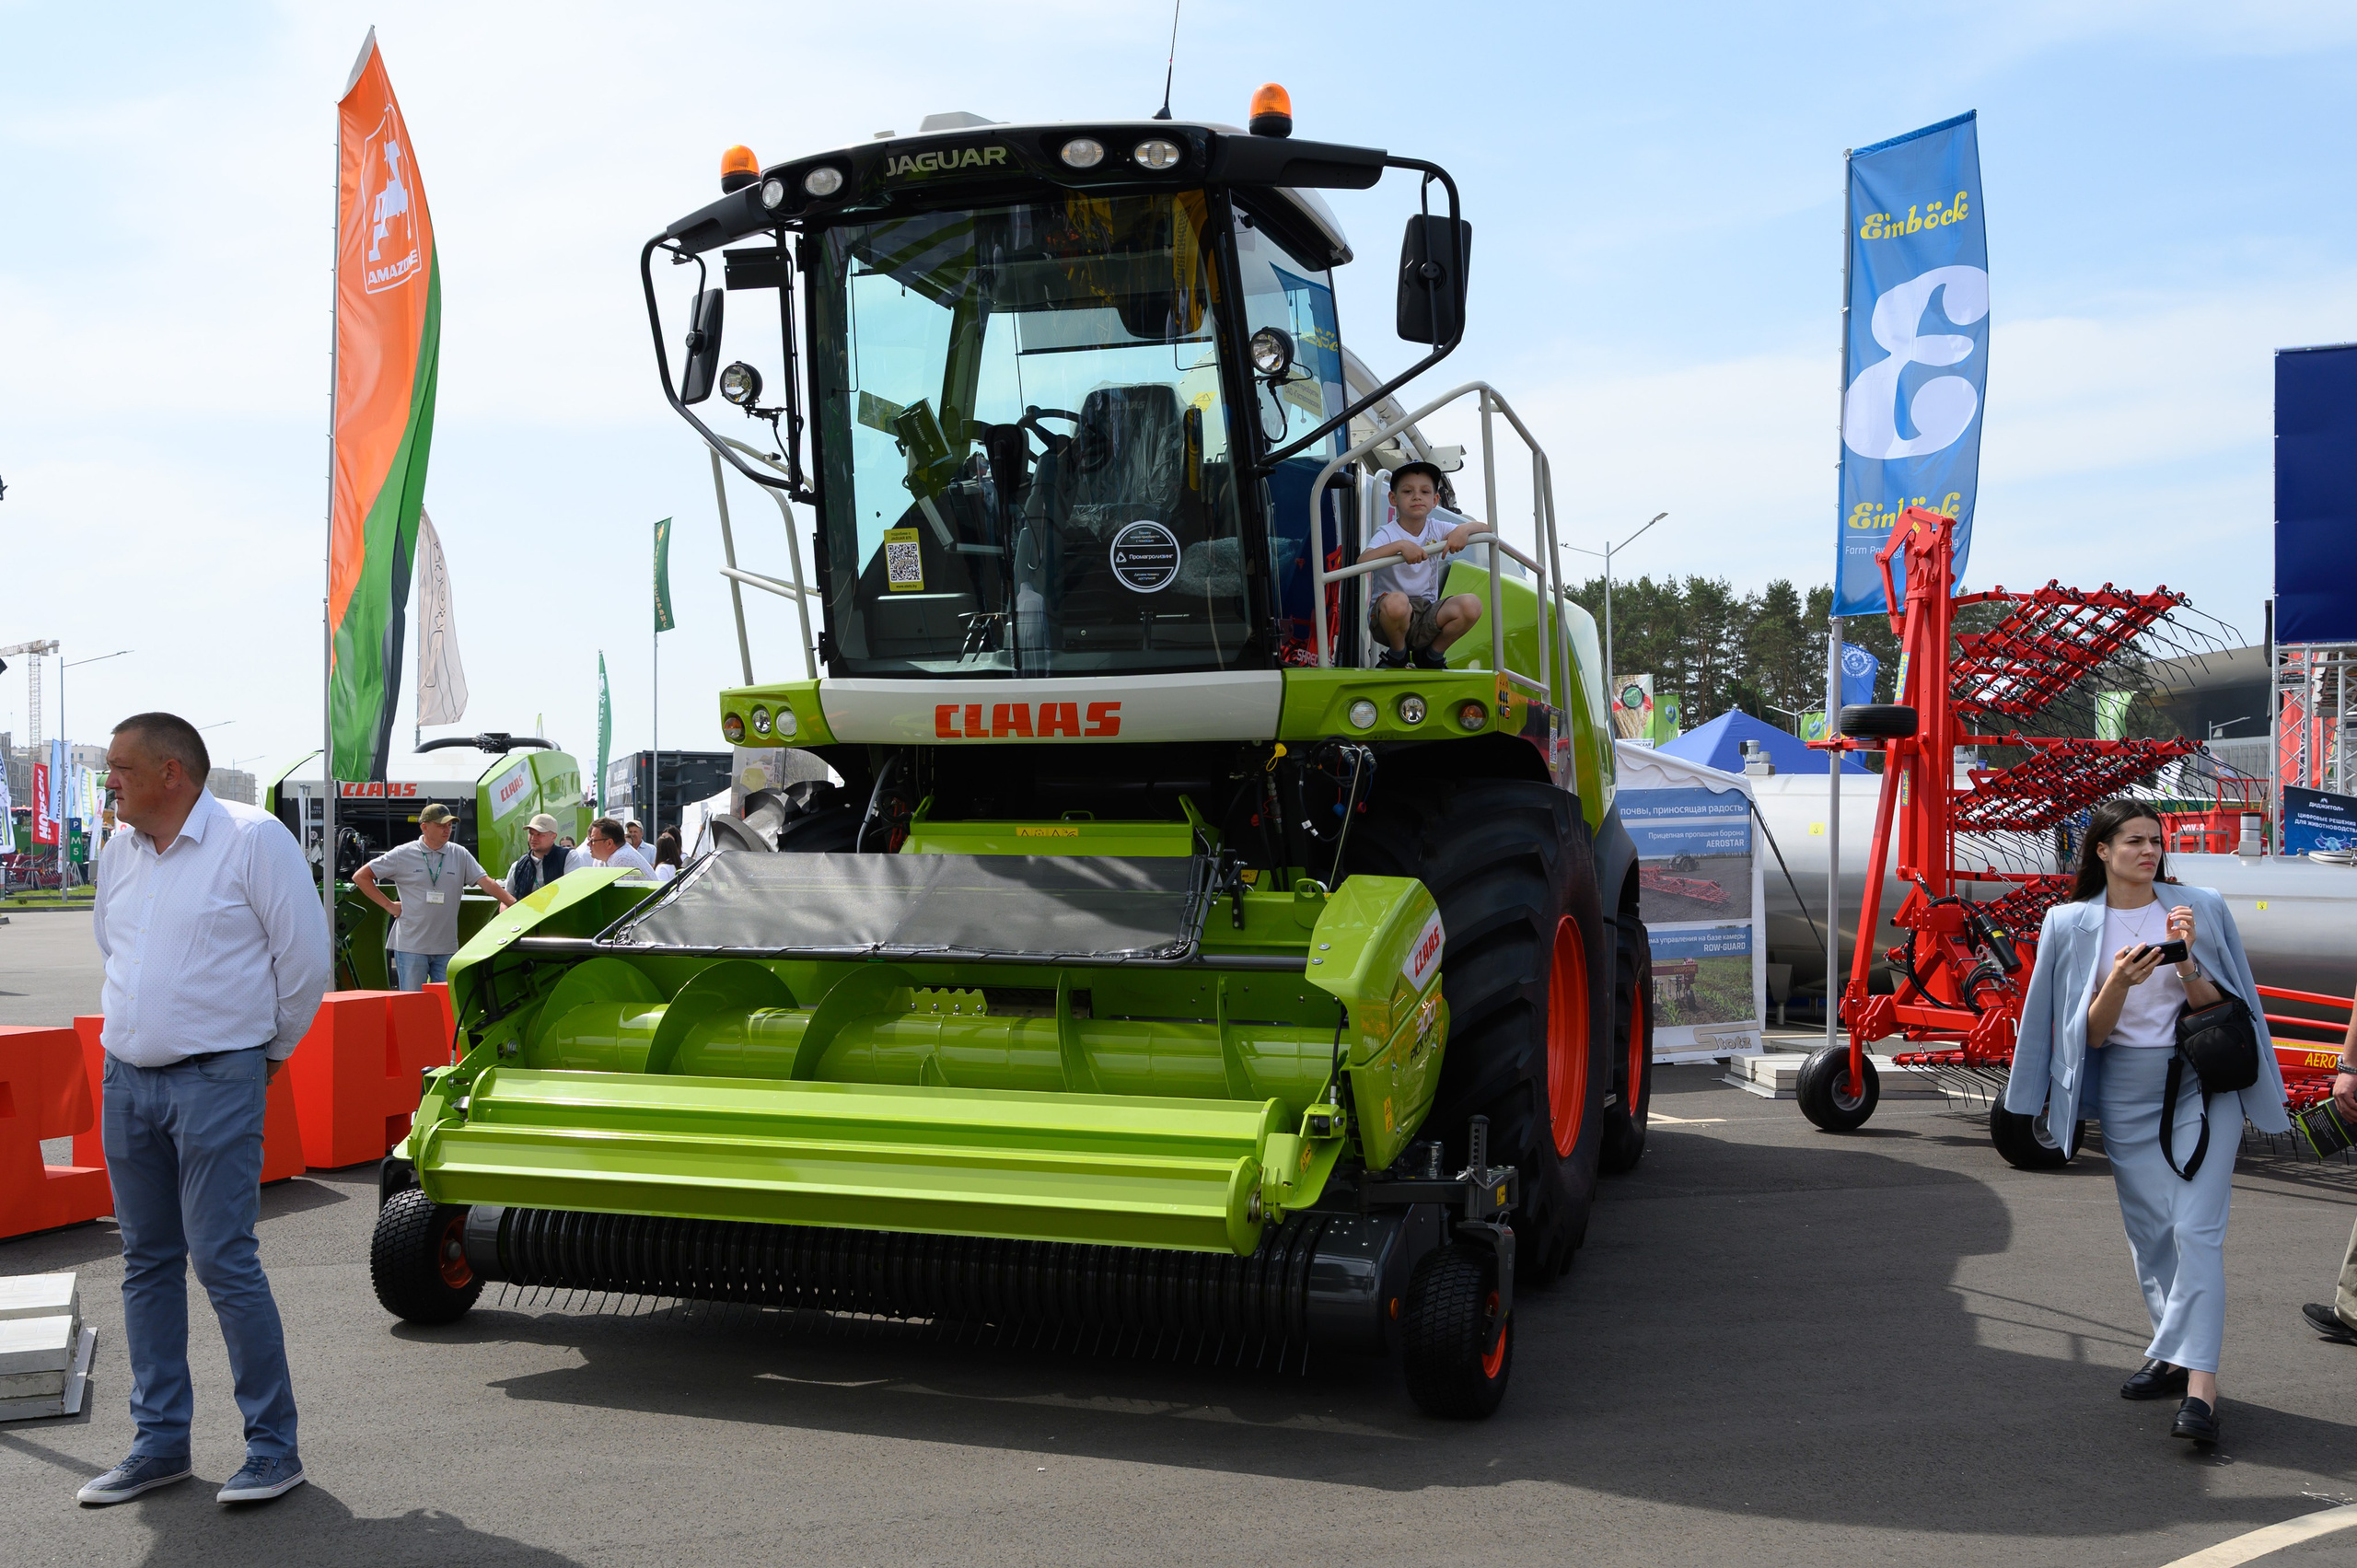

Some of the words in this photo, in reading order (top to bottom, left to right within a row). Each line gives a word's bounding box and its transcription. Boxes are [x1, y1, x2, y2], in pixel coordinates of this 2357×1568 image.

[886, 146, 1006, 177] JAGUAR
[1860, 191, 1969, 239] Einböck
[367, 249, 419, 285] AMAZONE
[1845, 545, 1867, 555] Farm
[935, 702, 1121, 738] CLAAS
[343, 783, 418, 797] CLAAS
[500, 773, 524, 803] CLAAS
[38, 768, 52, 841] HORSCH
[1620, 807, 1651, 816] почвы,
[1653, 805, 1706, 815] приносящая
[1708, 804, 1743, 814] радость
[2297, 812, 2328, 822] ЦИФРОВЫЕ
[2328, 818, 2357, 827] РЕШЕНИЯ
[71, 835, 82, 845] M
[1648, 831, 1684, 841] Прицепная
[1685, 830, 1719, 839] пропашная
[1719, 829, 1745, 837] борона
[1706, 839, 1745, 848] AEROSTAR
[73, 847, 79, 855] 5
[1660, 935, 1697, 945] управления
[1723, 933, 1747, 941] камеры
[1414, 925, 1440, 978] CLAAS
[1703, 942, 1746, 952] ROW-GUARD
[2305, 1052, 2338, 1069] AERO
